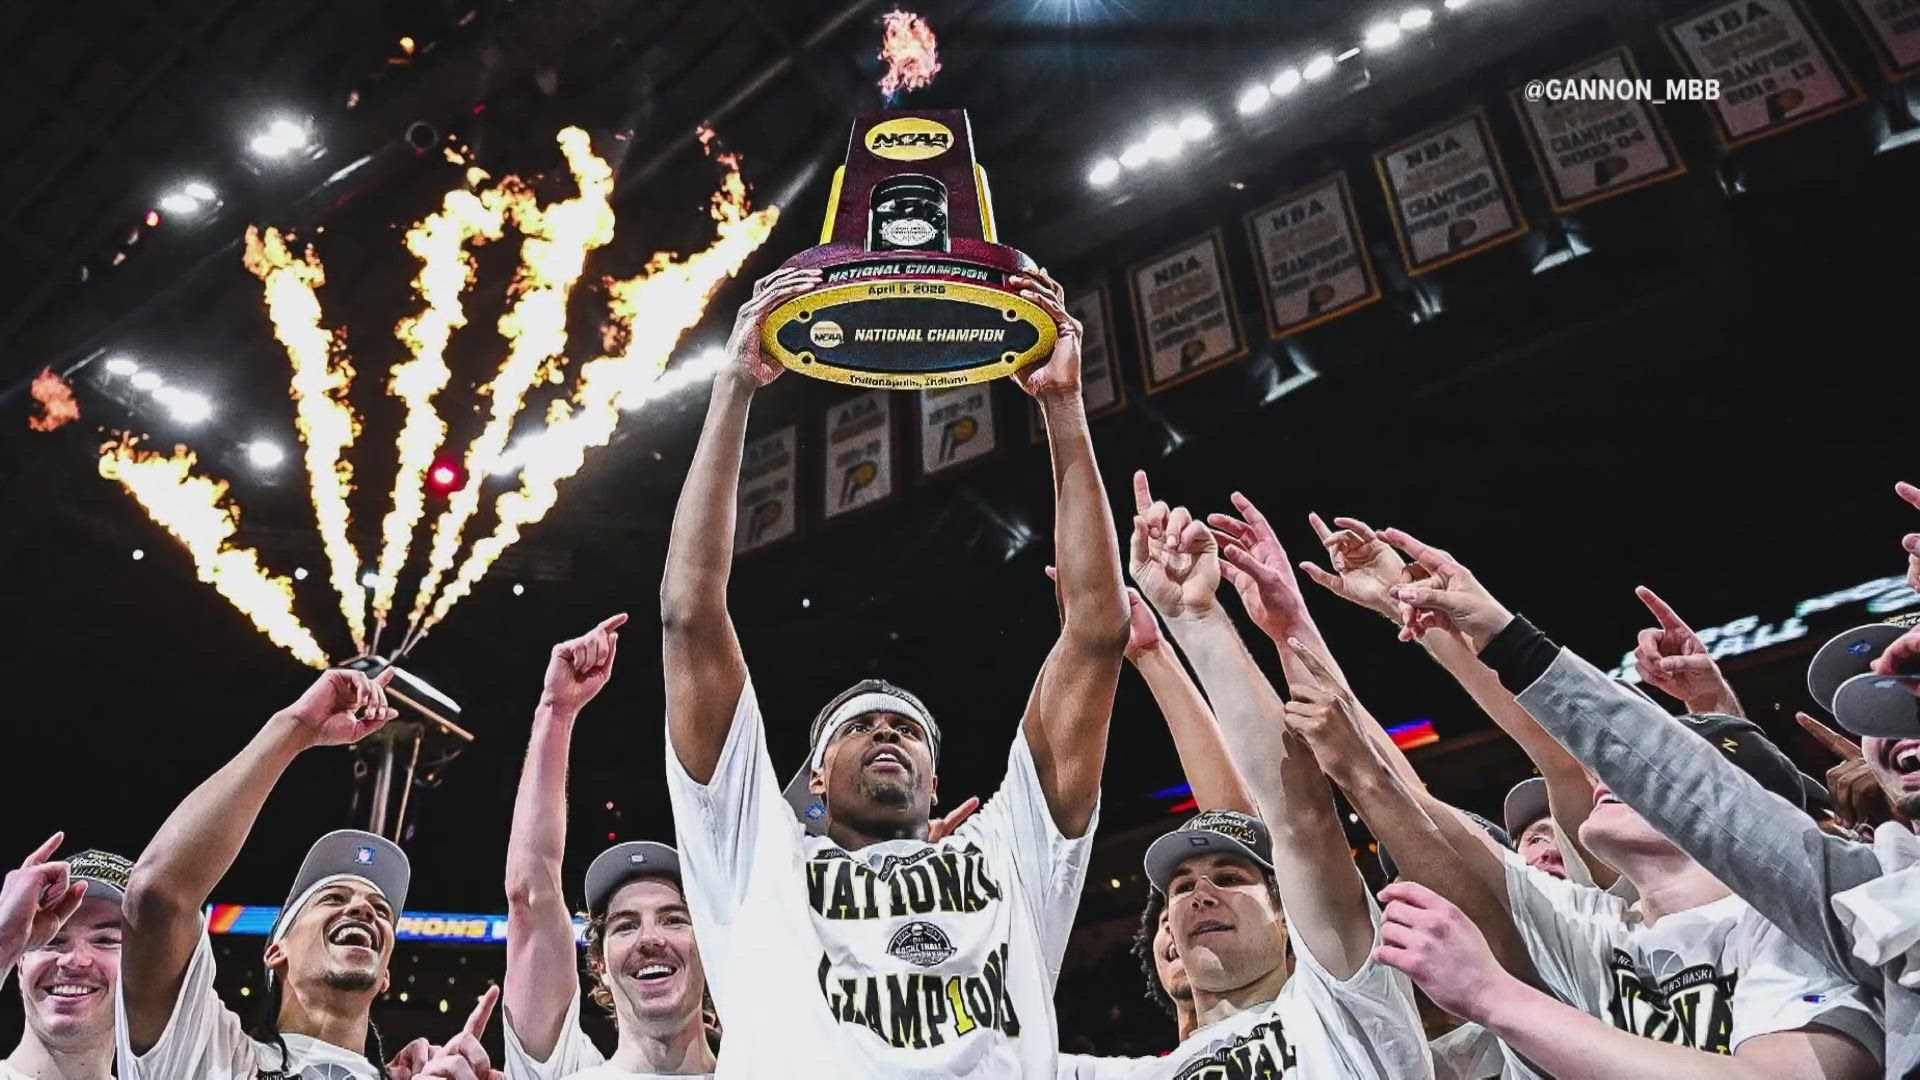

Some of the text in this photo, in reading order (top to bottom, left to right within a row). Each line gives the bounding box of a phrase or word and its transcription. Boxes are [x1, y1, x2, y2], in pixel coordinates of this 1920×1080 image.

[872, 133, 948, 150] NCAA
[828, 263, 988, 283] NATIONAL CHAMPION
[854, 328, 1005, 343] NATIONAL CHAMPION
[806, 851, 1003, 920] NATIONAL
